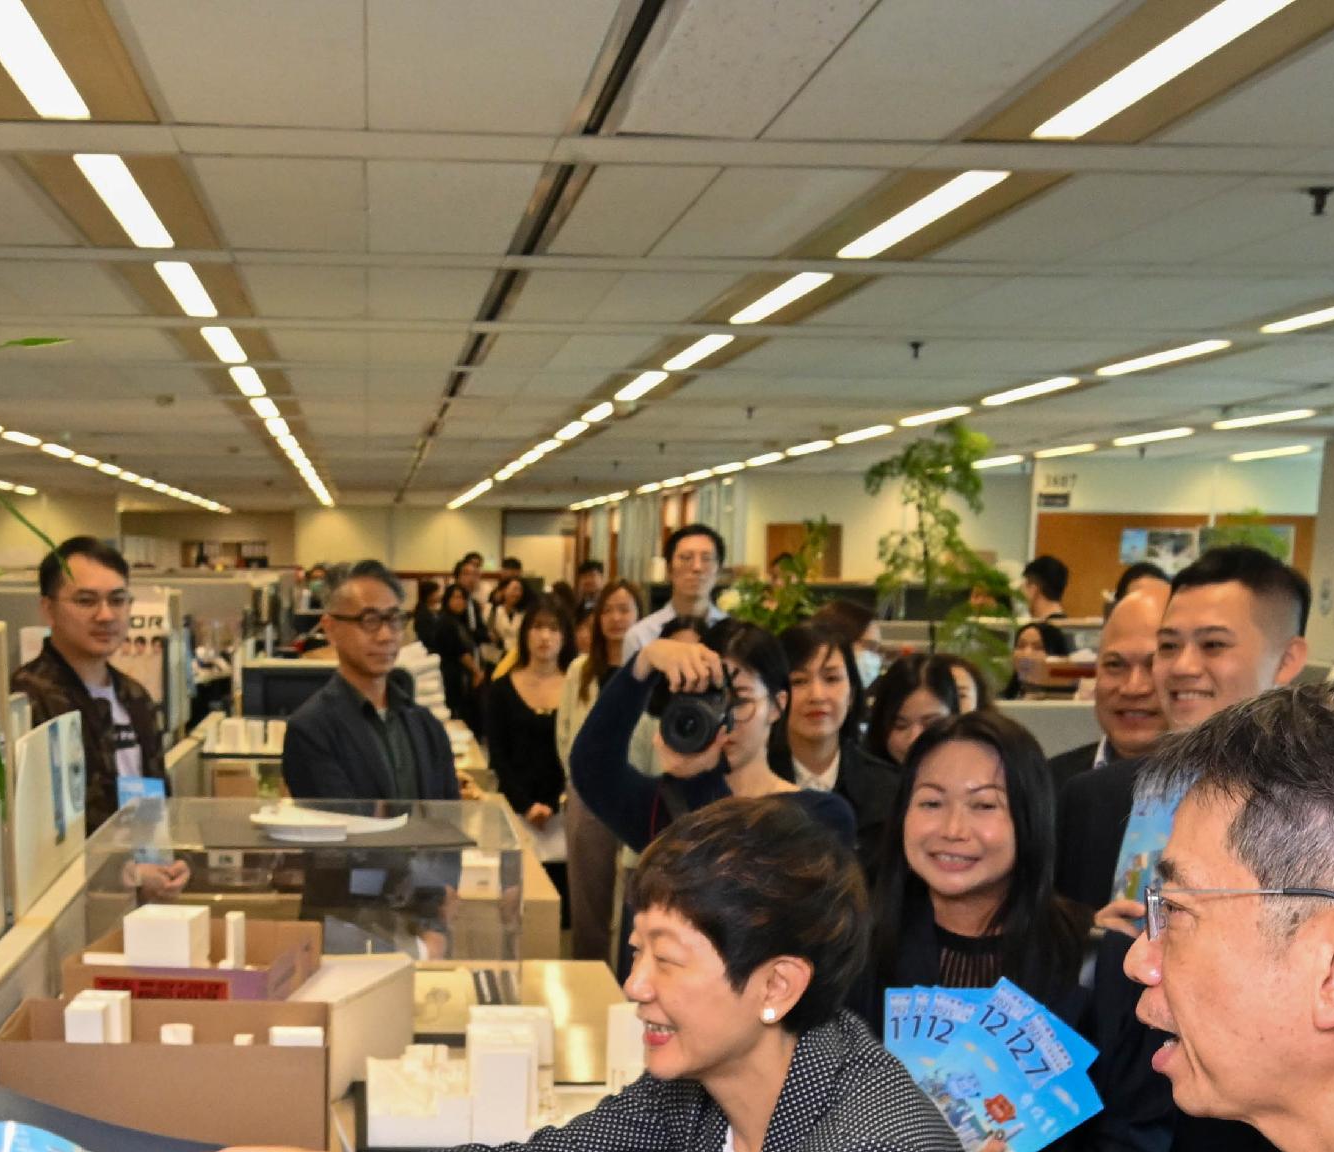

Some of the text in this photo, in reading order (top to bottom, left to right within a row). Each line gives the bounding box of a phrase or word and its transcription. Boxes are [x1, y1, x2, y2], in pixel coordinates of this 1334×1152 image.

[927, 1015, 955, 1044] 12
[978, 1004, 1008, 1037] 12
[1005, 1029, 1035, 1061] 12
